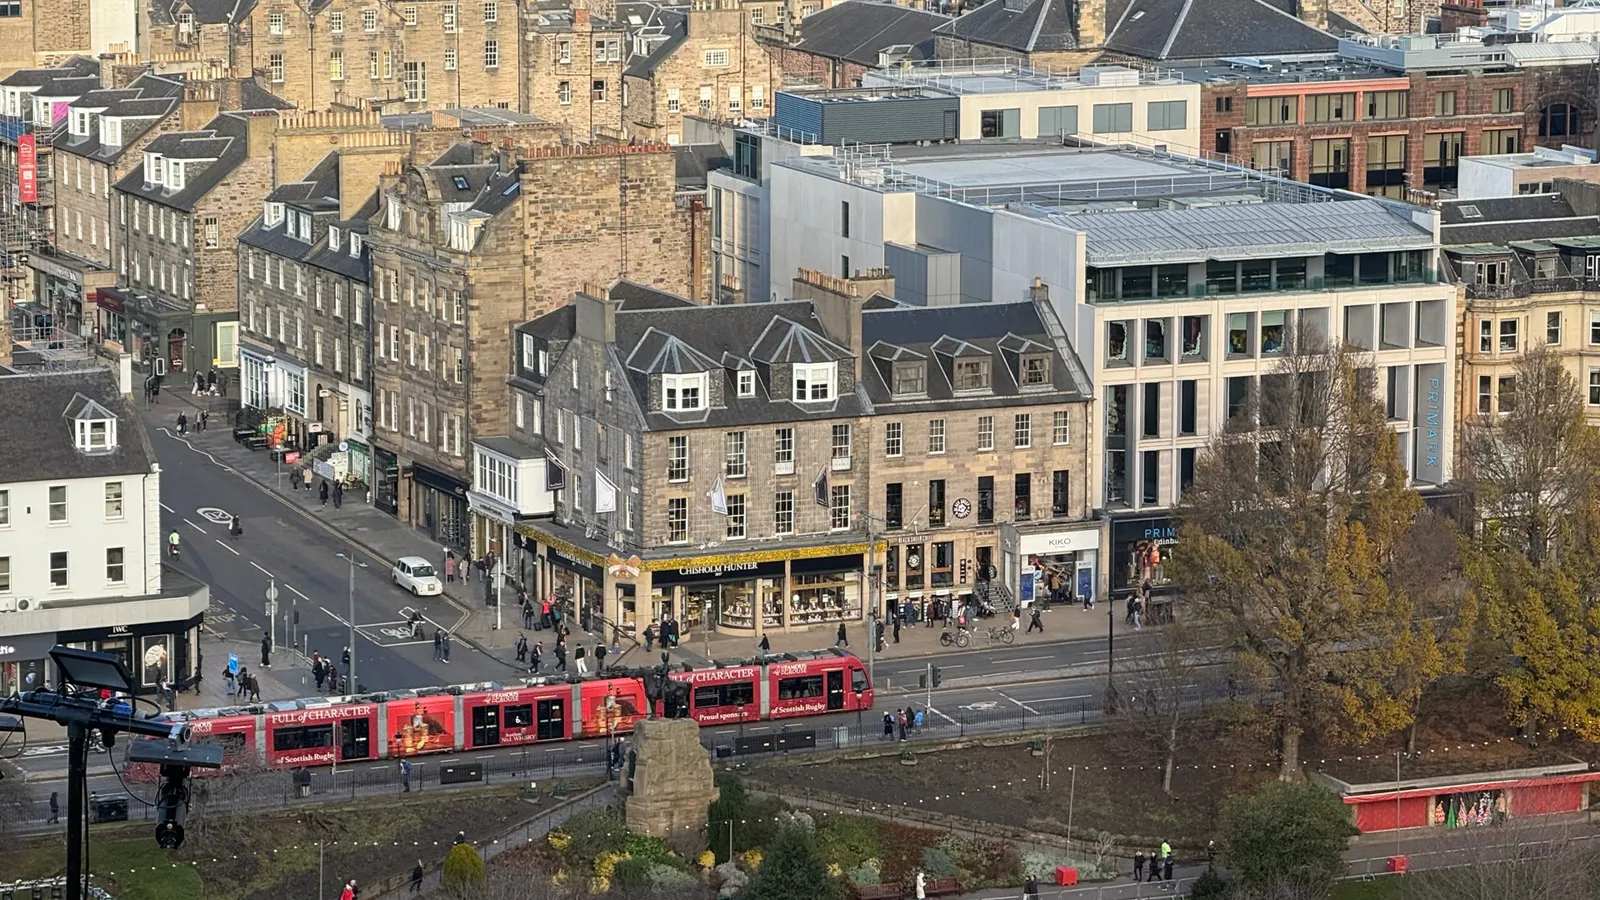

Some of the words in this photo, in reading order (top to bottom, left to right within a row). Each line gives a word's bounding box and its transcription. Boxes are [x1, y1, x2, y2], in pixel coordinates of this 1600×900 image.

[1426, 378, 1439, 467] PRIMARK
[1144, 527, 1176, 538] PRIM
[1048, 538, 1071, 546] KIKO
[1153, 537, 1179, 545] Edinbu
[679, 565, 722, 576] CHISHOLM
[723, 562, 758, 572] HUNTER
[112, 626, 128, 634] IWC
[696, 668, 755, 682] CHARACTER
[778, 704, 804, 713] Scottish
[805, 702, 826, 711] Rugby
[272, 713, 297, 724] FULL
[297, 713, 308, 723] of
[308, 705, 371, 720] CHARACTER
[699, 712, 719, 721] Proud
[719, 711, 748, 720] sponsrs
[277, 756, 284, 764] of
[284, 753, 313, 763] Scottish
